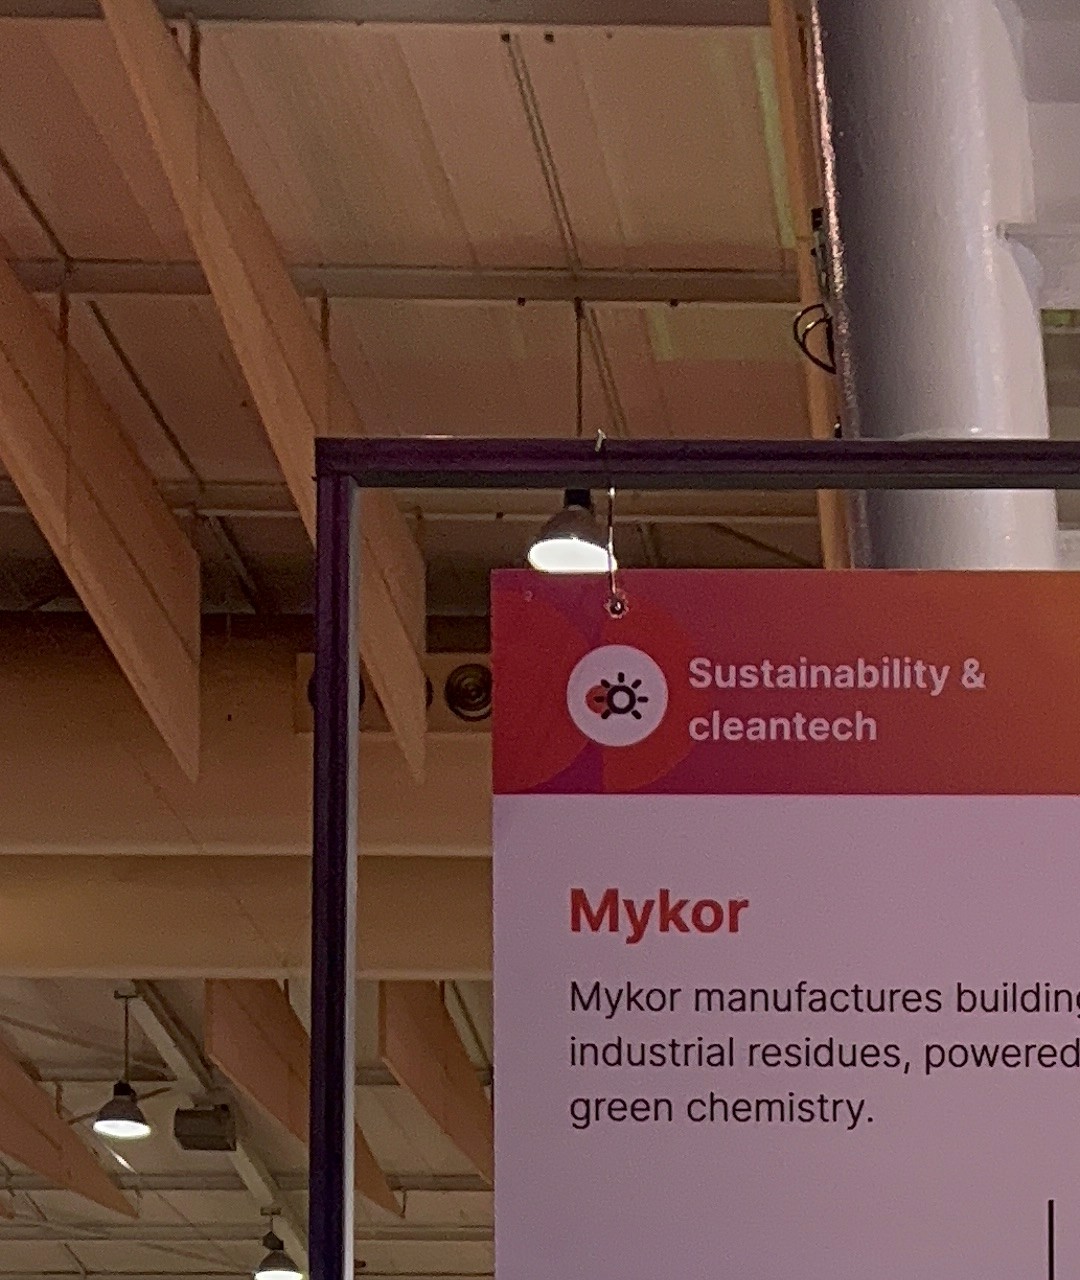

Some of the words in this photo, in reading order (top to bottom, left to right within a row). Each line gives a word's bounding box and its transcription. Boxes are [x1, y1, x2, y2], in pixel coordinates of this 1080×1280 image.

[689, 657, 950, 696] Sustainability
[962, 658, 986, 688] &
[689, 711, 876, 740] cleantech
[571, 888, 749, 944] Mykor
[571, 981, 681, 1019] Mykor
[695, 981, 941, 1012] manufactures
[571, 1036, 733, 1066] industrial
[749, 1037, 909, 1074] residues,
[926, 1038, 1079, 1075] powered
[571, 1098, 672, 1129] green
[687, 1092, 873, 1130] chemistry.
